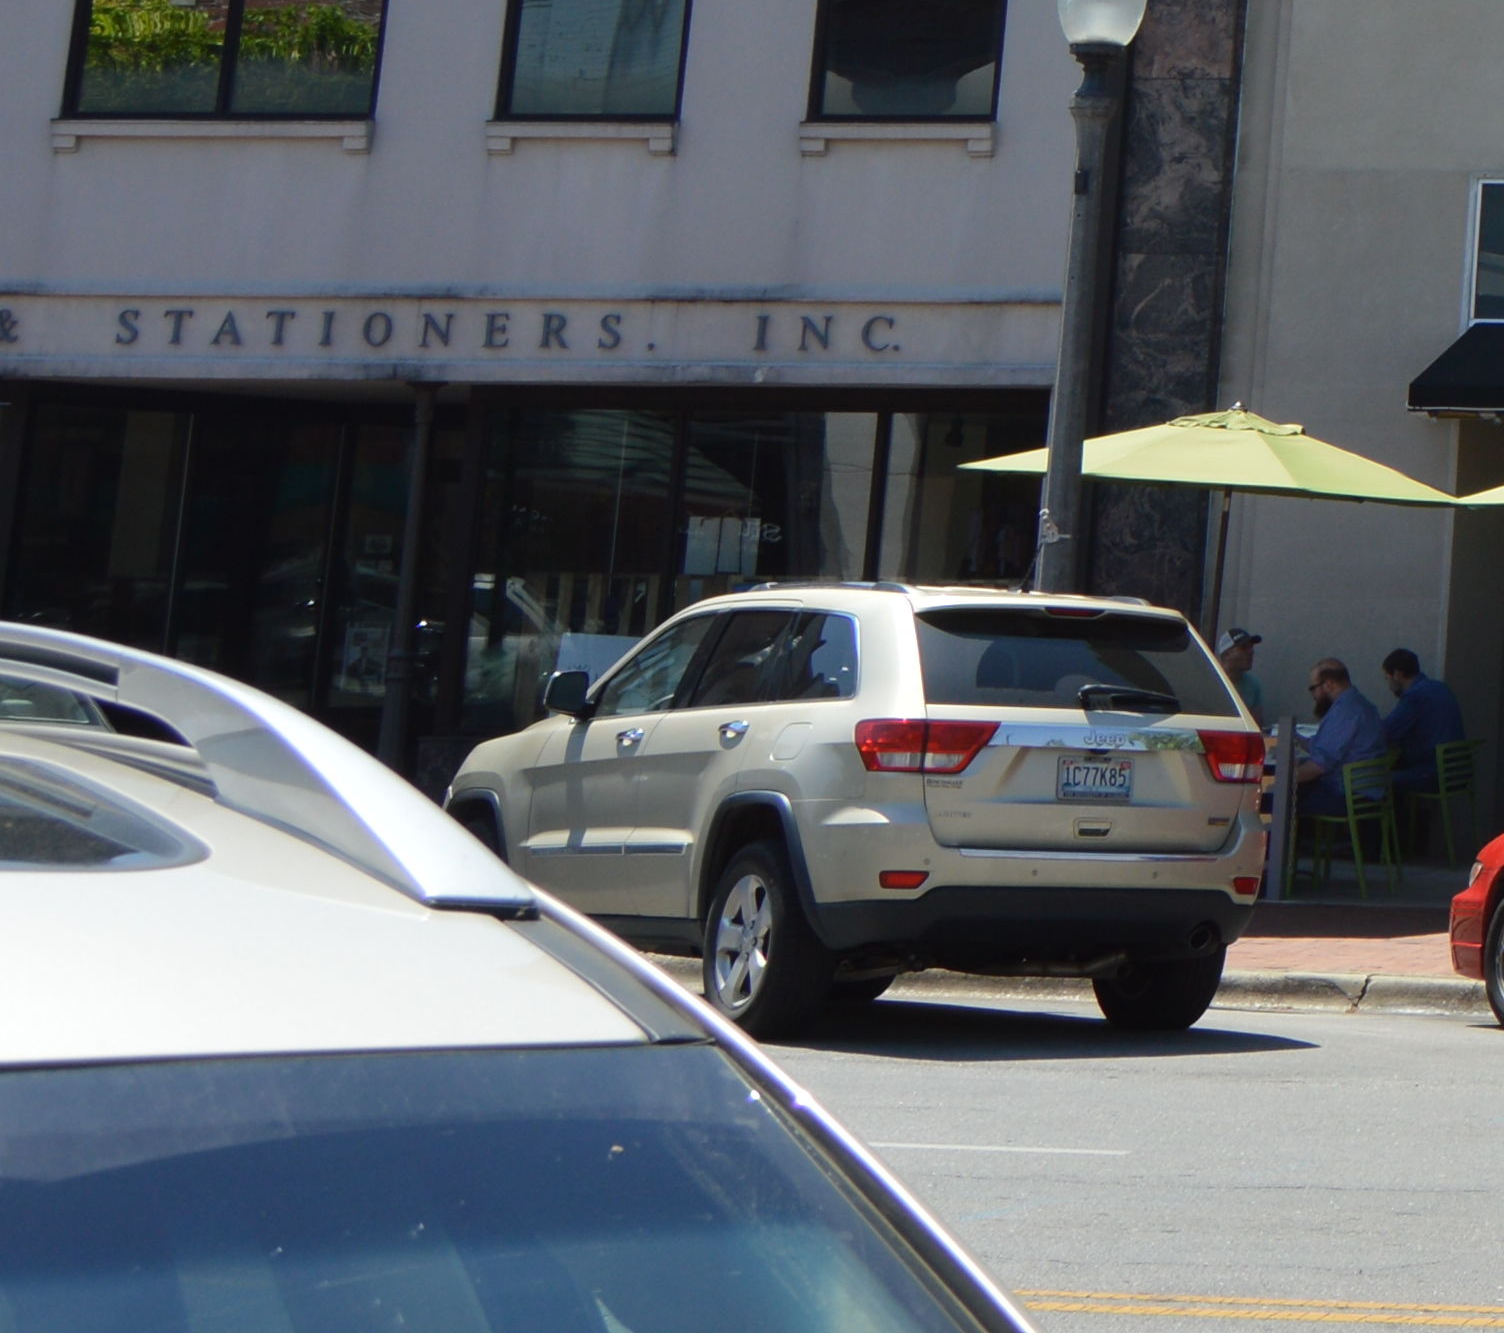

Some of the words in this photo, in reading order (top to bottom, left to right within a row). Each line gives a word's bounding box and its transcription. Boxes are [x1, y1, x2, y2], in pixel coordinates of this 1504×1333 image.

[753, 314, 901, 352] INC.
[1083, 730, 1126, 748] Jeep
[1062, 765, 1127, 787] 1C77K85
